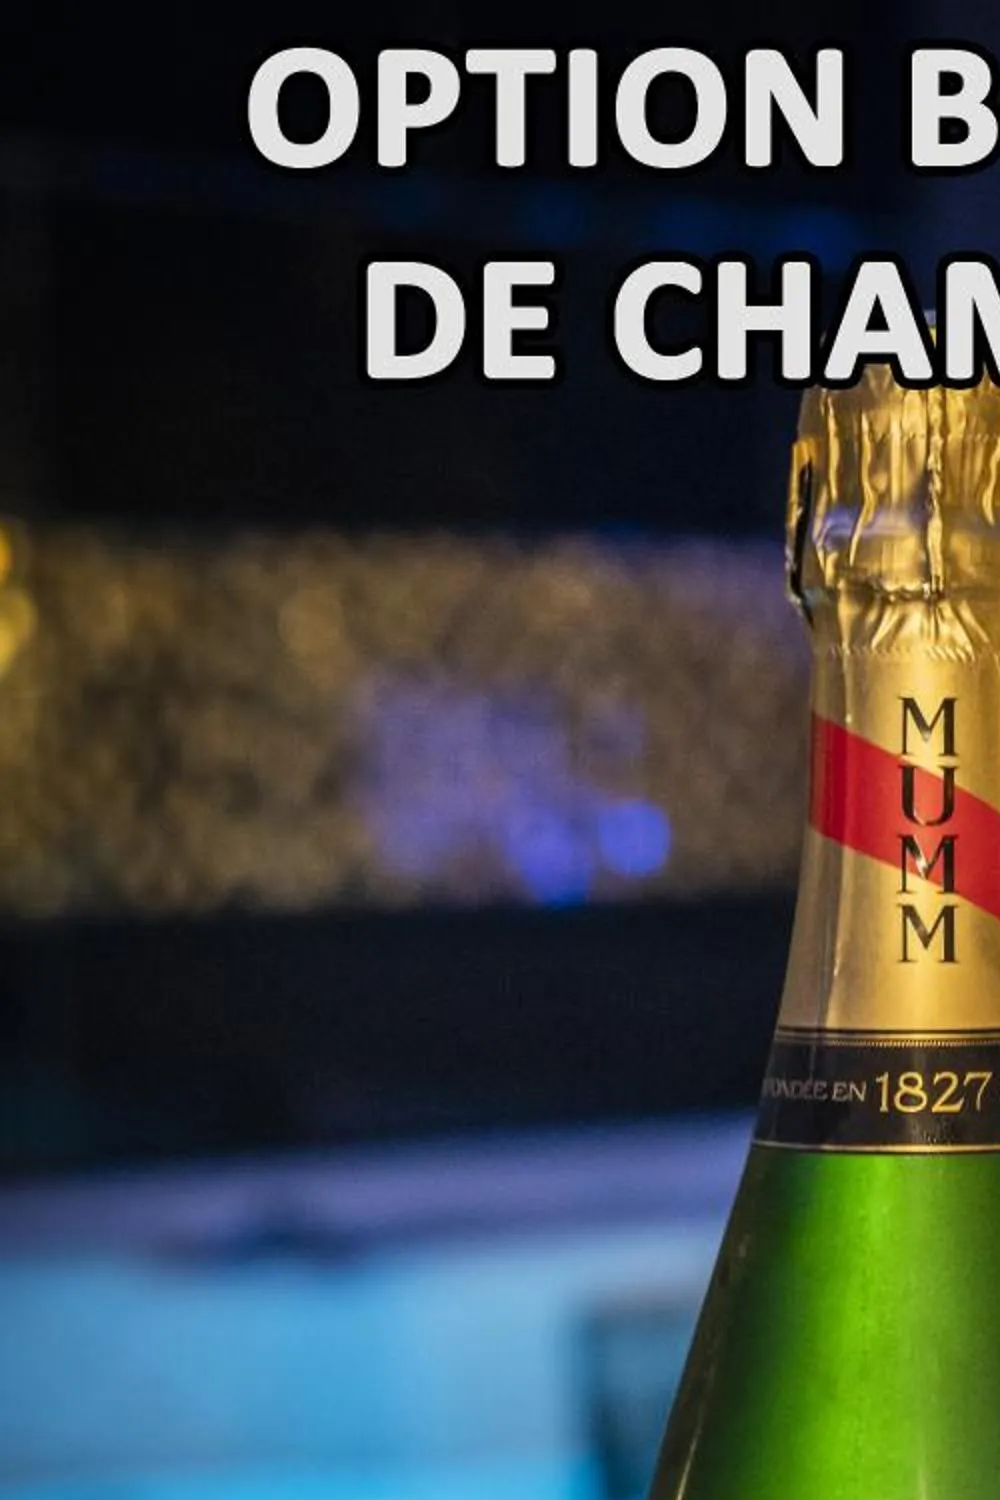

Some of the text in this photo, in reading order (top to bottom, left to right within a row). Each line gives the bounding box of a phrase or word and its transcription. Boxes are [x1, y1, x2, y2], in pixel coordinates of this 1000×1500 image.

[897, 696, 960, 964] MUMM
[831, 1080, 868, 1102] EN
[875, 1071, 993, 1114] 1827
